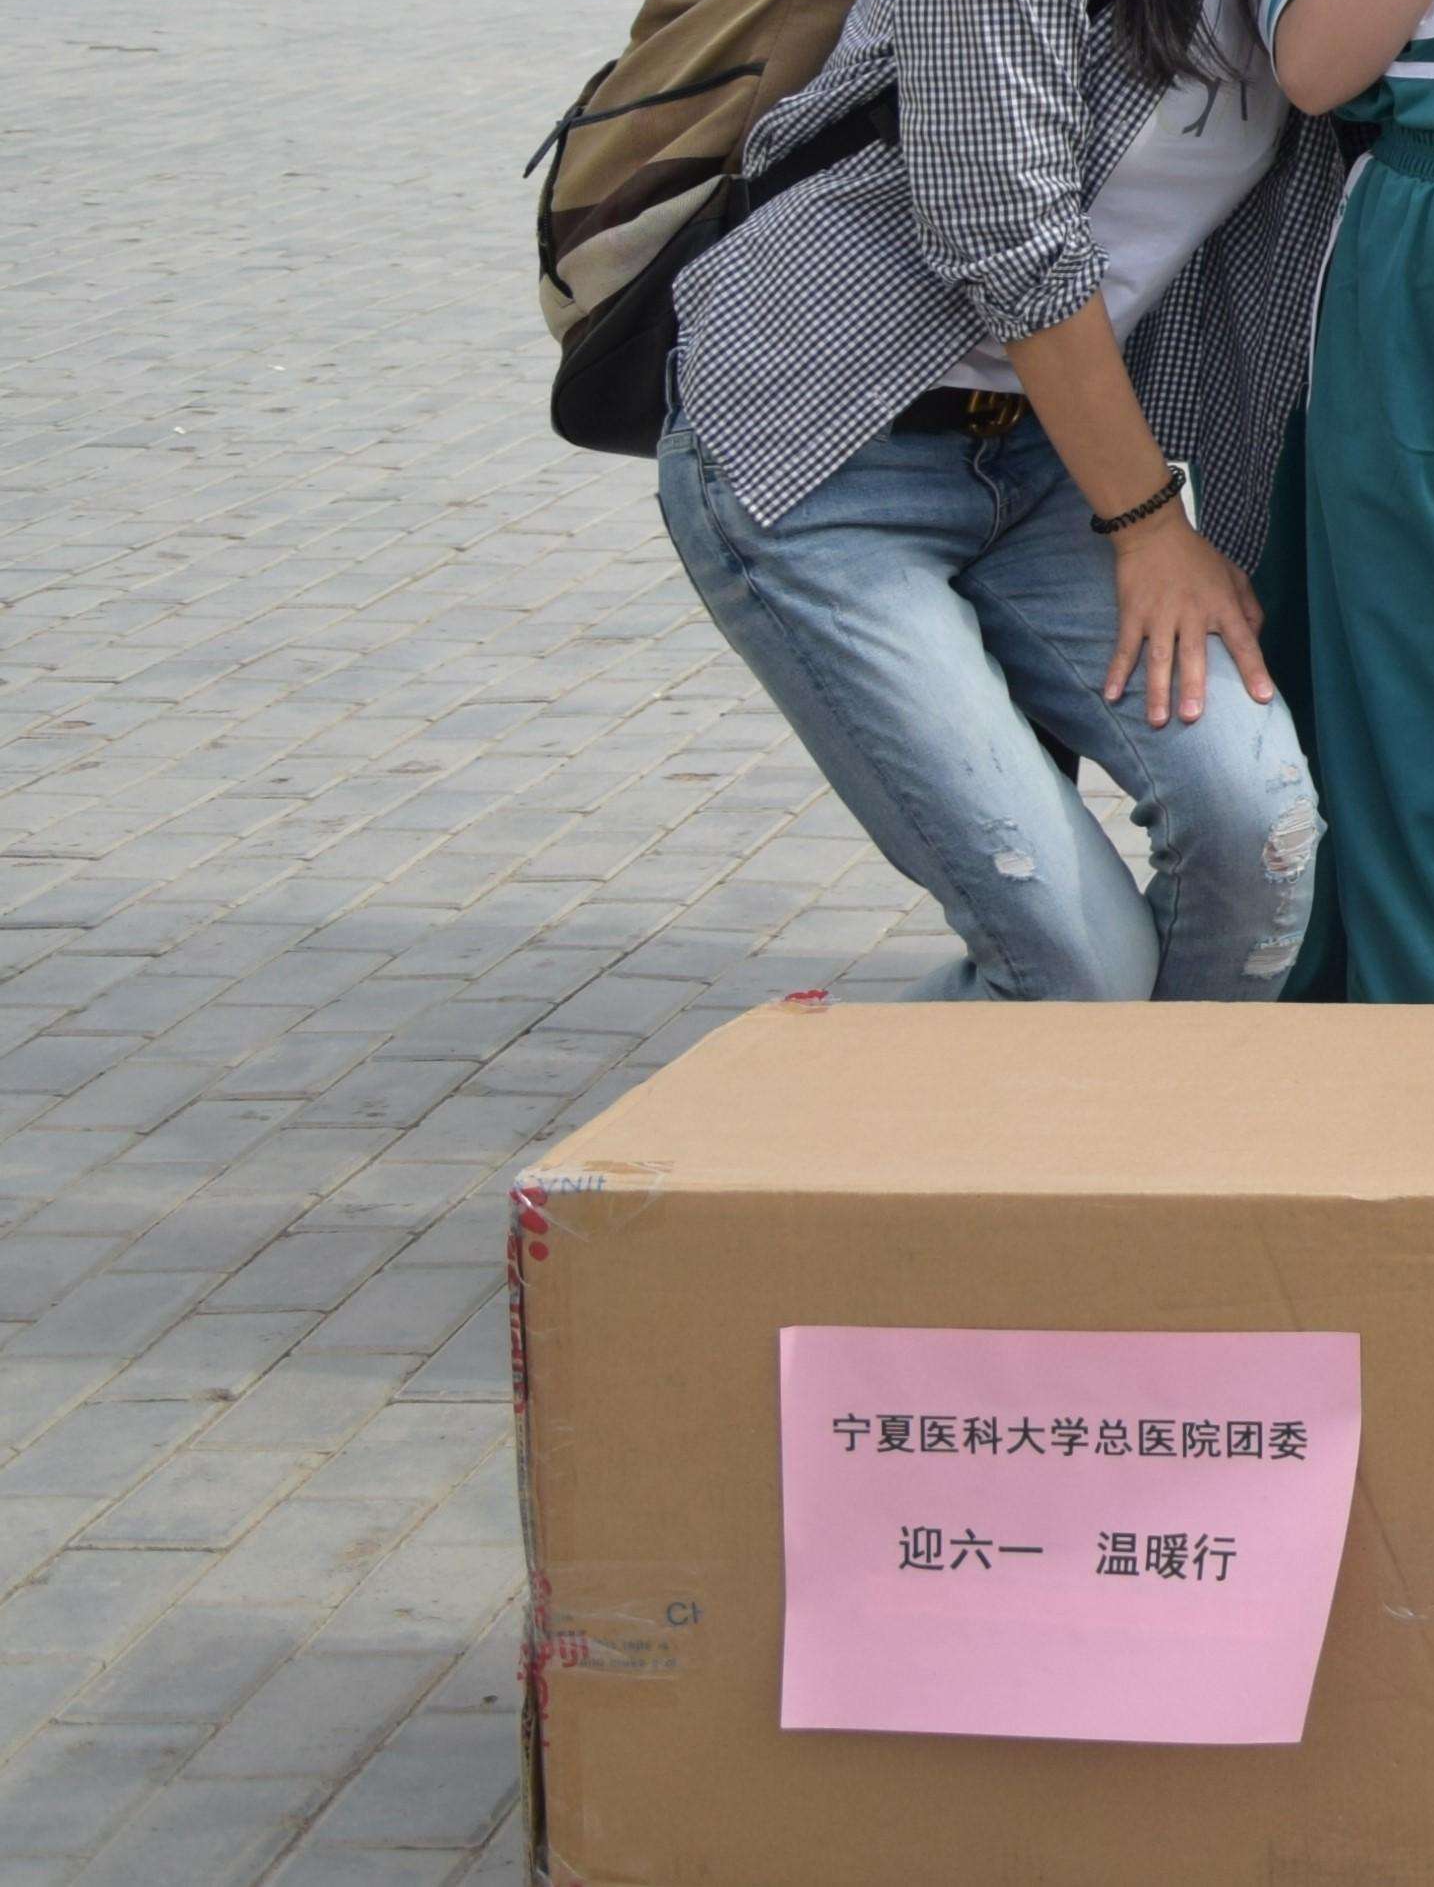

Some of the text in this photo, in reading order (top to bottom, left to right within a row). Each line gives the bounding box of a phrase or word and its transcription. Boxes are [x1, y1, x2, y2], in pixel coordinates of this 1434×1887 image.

[832, 1412, 1308, 1461] 宁夏医科大学总医院团委
[898, 1525, 1237, 1582] 迎六一 温暖行
